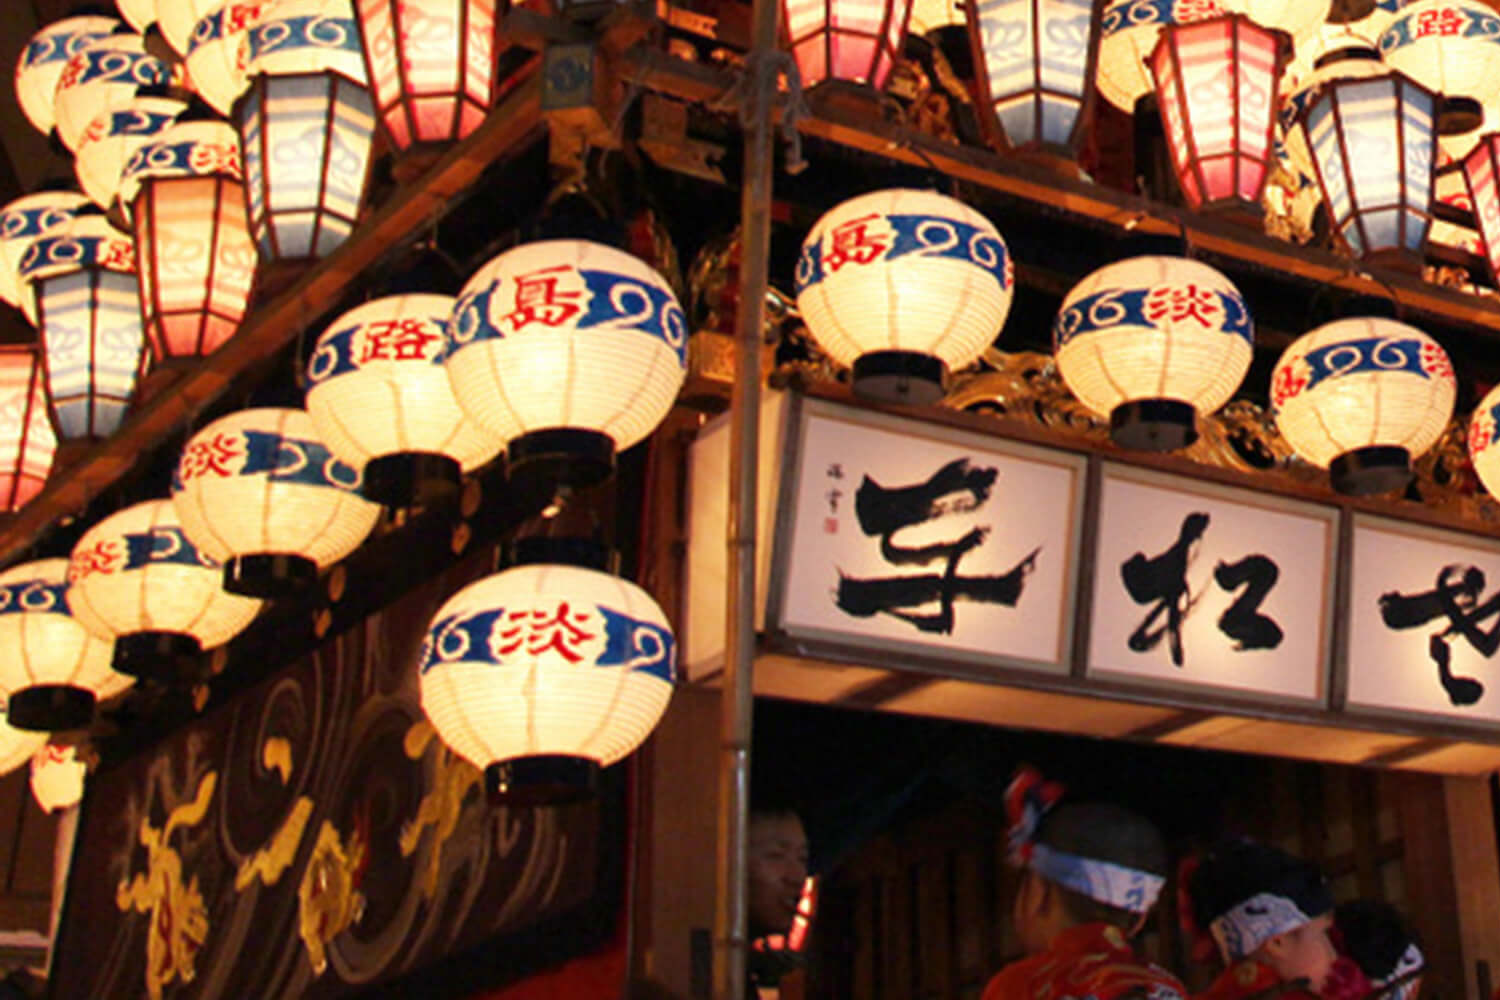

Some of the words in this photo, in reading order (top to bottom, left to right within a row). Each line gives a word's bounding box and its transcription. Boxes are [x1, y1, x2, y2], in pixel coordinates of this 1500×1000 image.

[1417, 9, 1463, 38] 路
[821, 213, 892, 272] 島
[501, 264, 582, 331] 島
[1147, 284, 1223, 329] 淡
[360, 319, 441, 366] 路
[182, 433, 246, 480] 淡
[498, 602, 597, 664] 淡
